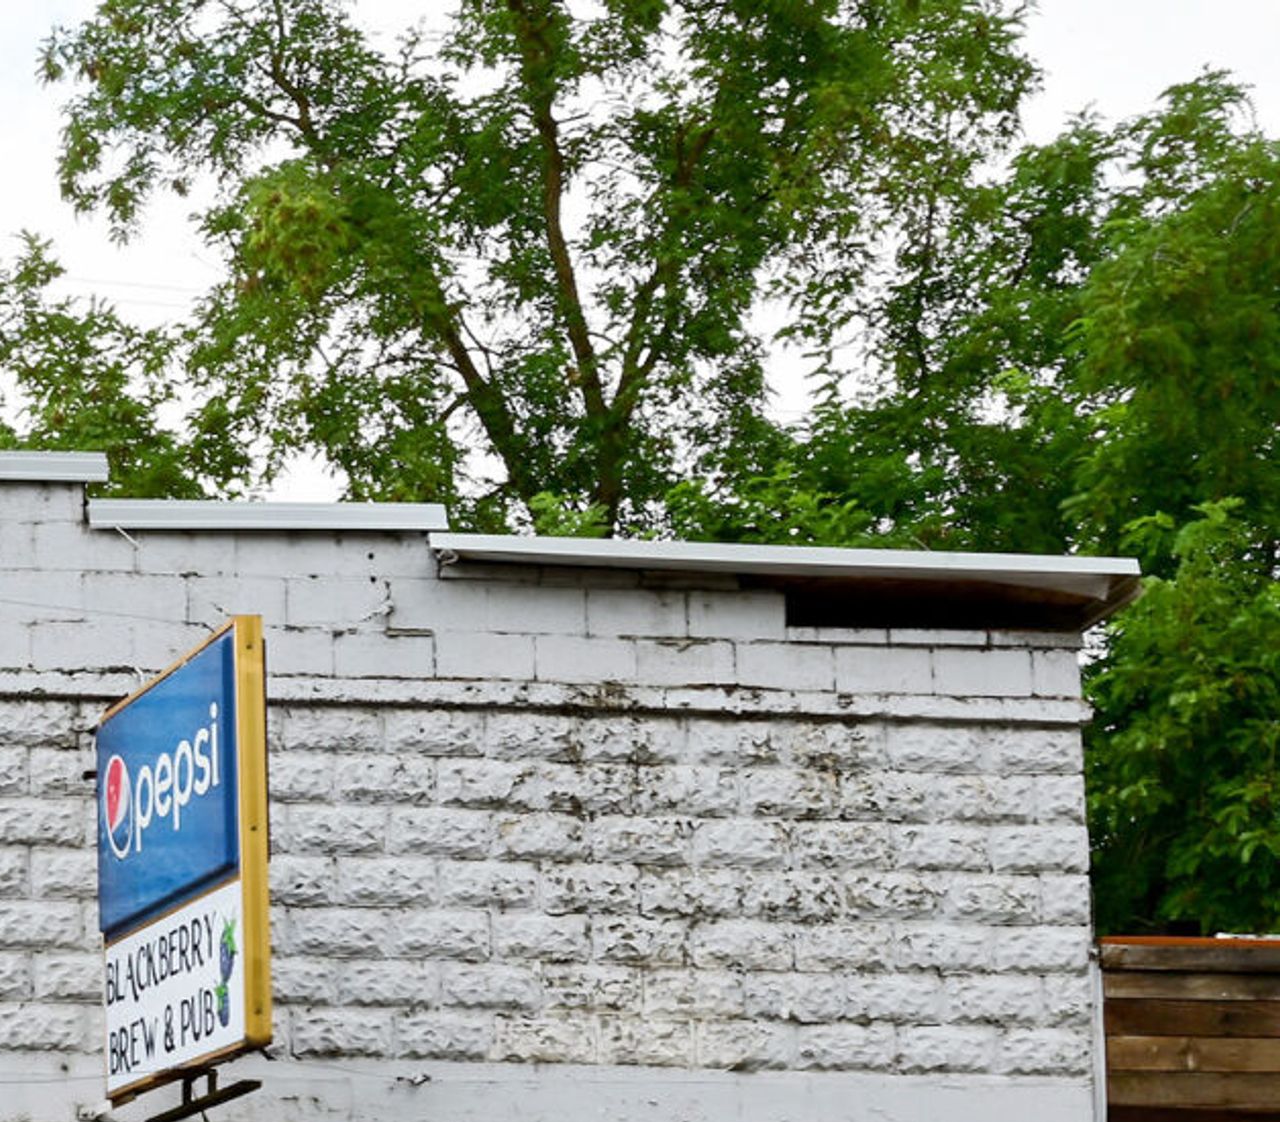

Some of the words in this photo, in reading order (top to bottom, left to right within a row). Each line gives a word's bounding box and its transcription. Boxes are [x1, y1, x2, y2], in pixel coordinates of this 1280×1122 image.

[134, 702, 221, 852] pepsi
[106, 911, 217, 1006] BLACKBERRY
[109, 1017, 158, 1075] BREW
[164, 1004, 176, 1053] &
[180, 988, 215, 1047] PUB
